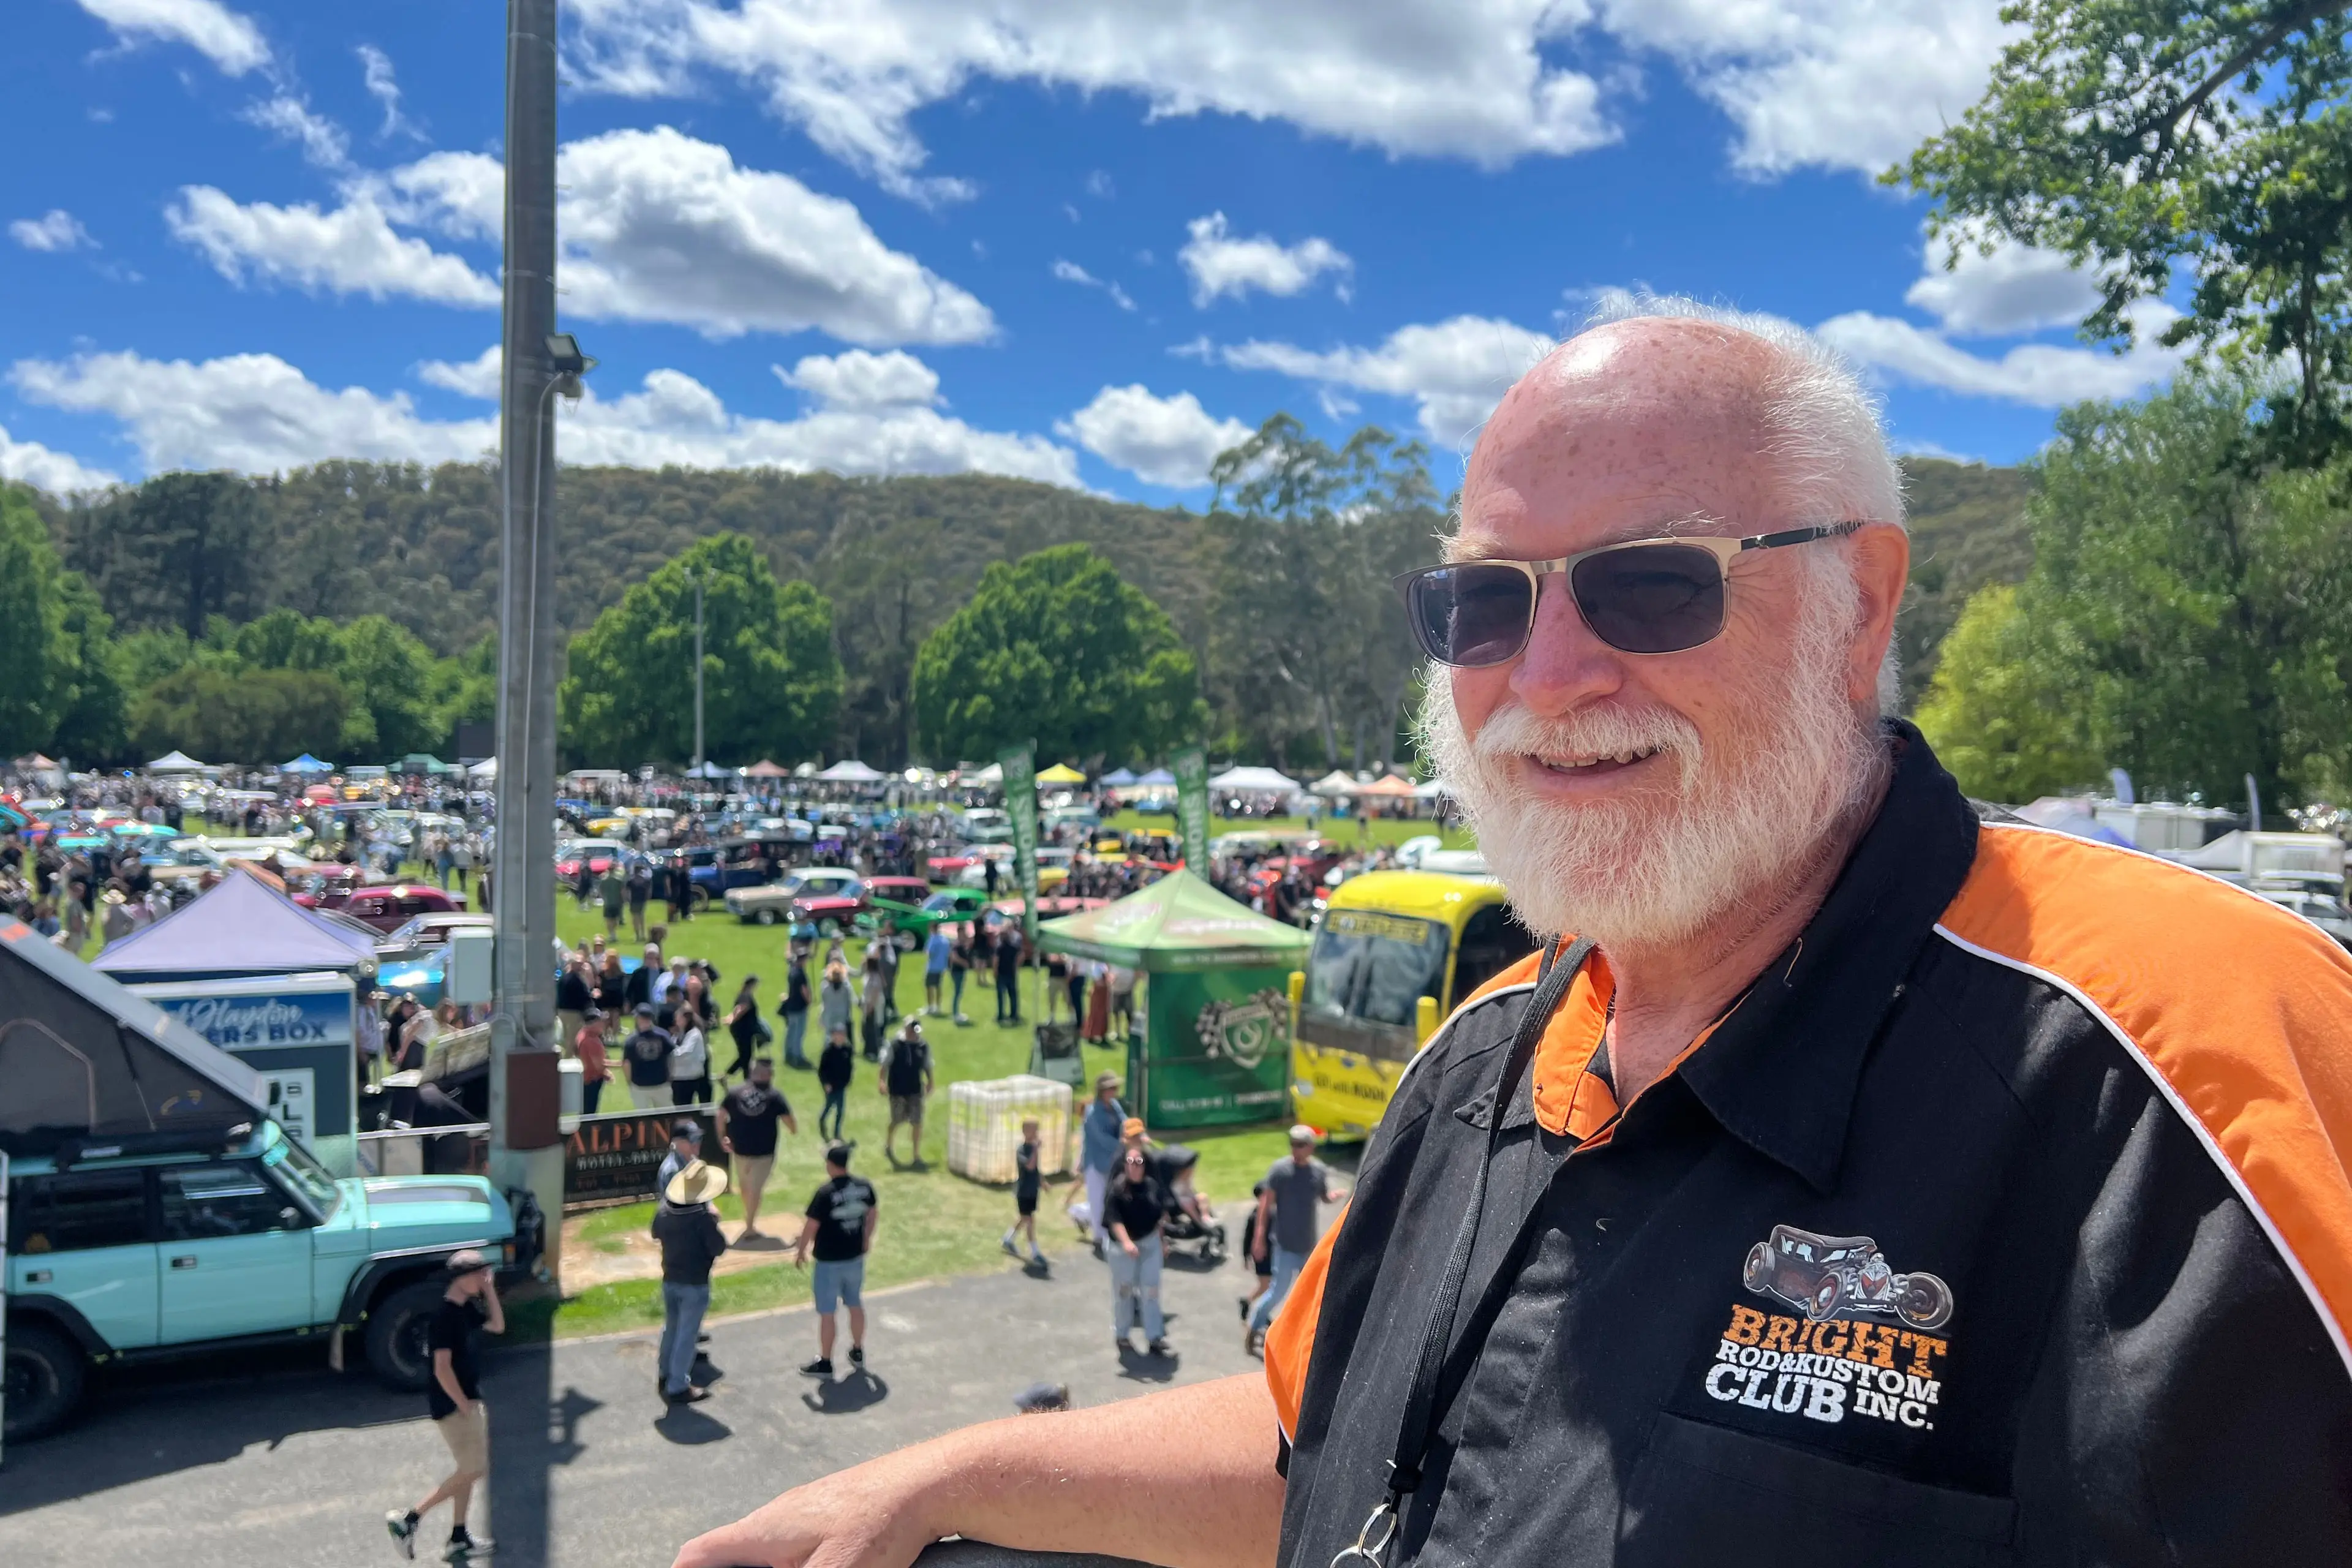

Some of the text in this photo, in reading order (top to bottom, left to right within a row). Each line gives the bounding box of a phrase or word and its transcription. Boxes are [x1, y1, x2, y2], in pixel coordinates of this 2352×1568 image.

[269, 1021, 328, 1041] BOX
[567, 1120, 673, 1157] ALPIN
[1723, 1304, 1948, 1379] BRIGHT
[1705, 1363, 1934, 1430] CLUB INC.
